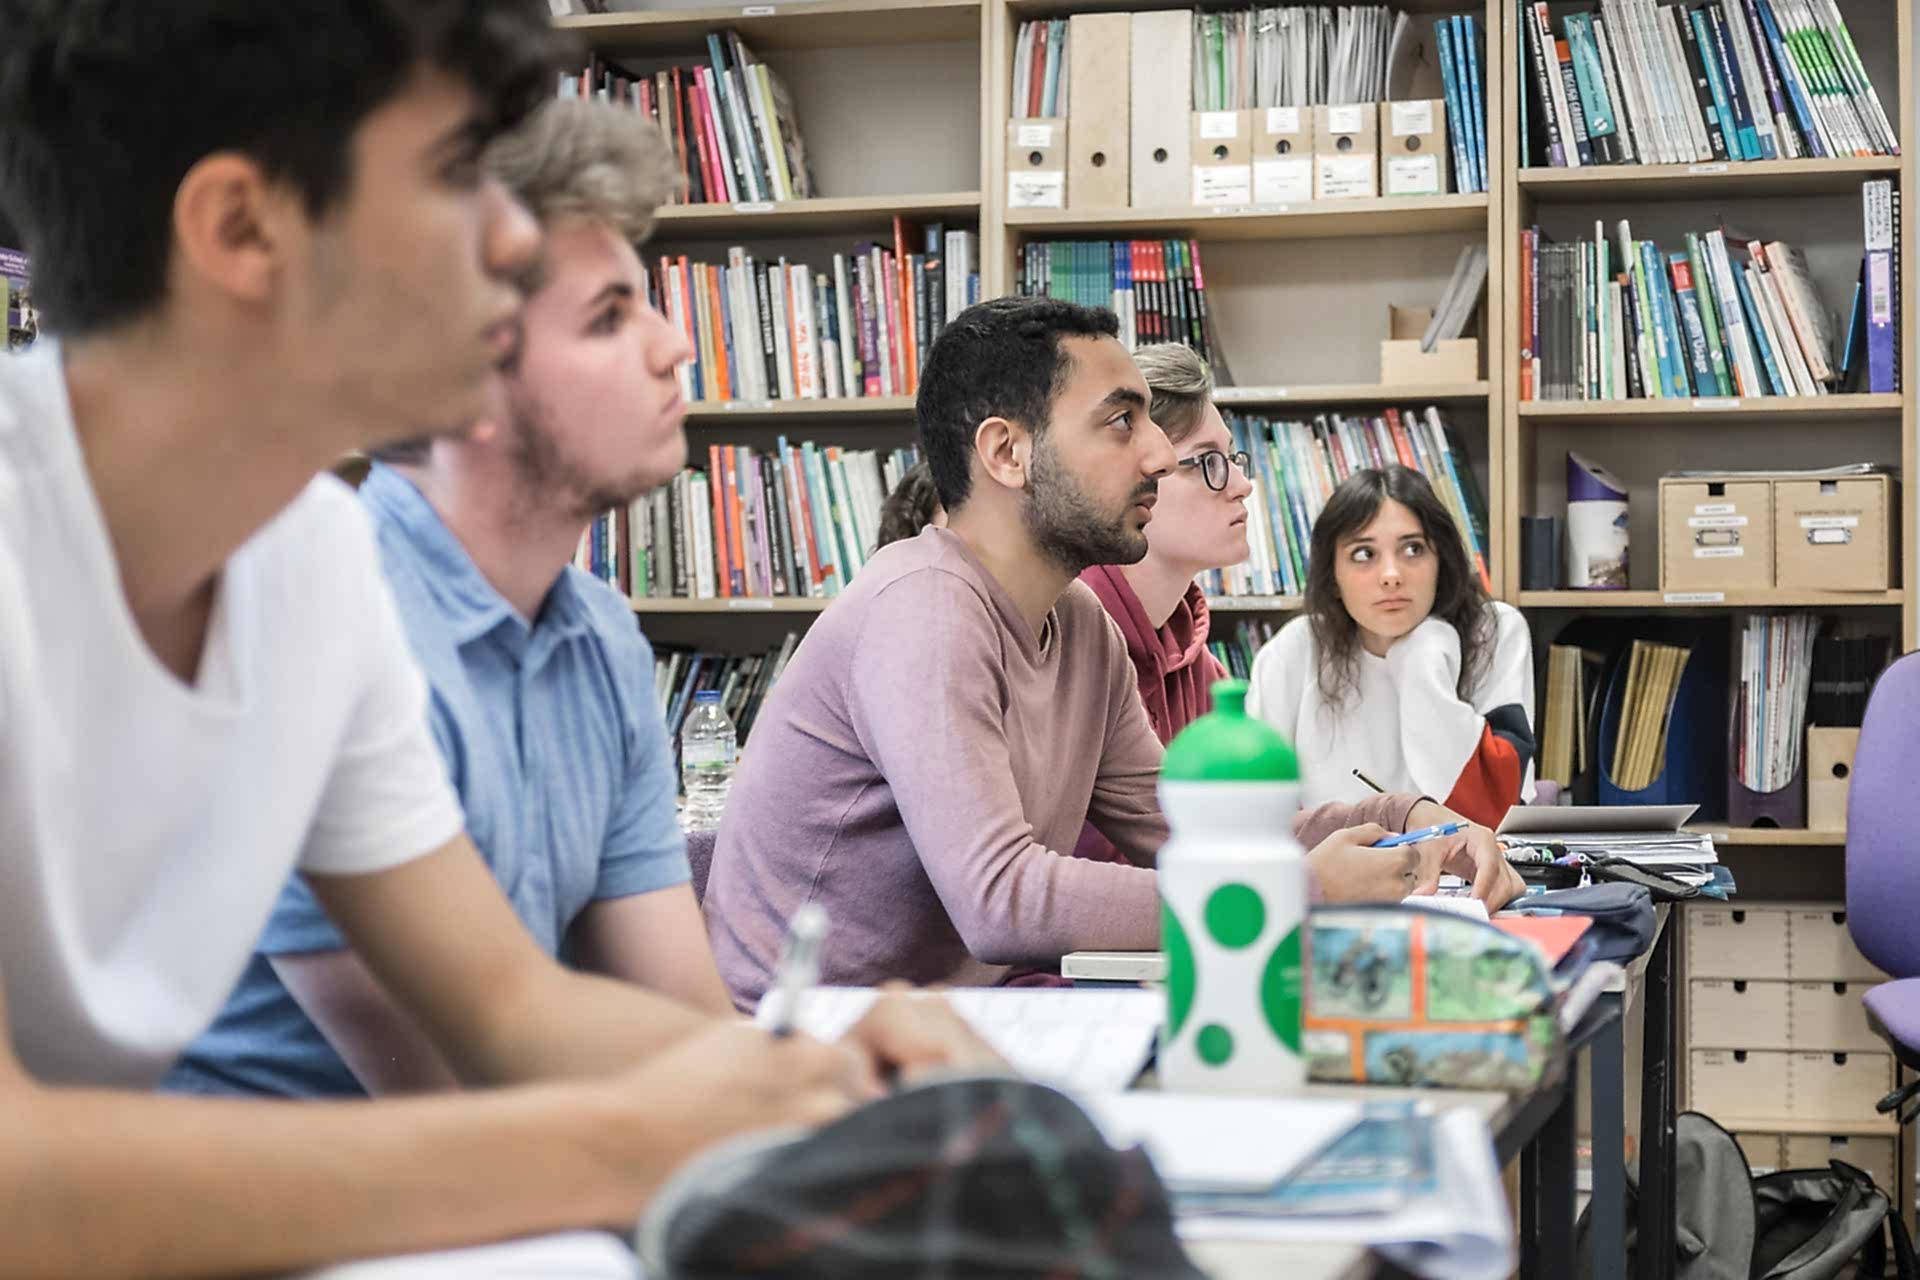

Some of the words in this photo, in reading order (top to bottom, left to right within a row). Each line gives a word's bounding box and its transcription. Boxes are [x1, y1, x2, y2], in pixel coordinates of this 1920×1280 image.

[1561, 68, 1579, 101] ENGLISH
[1568, 102, 1587, 143] GRAMMAR
[1693, 340, 1708, 374] Usage
